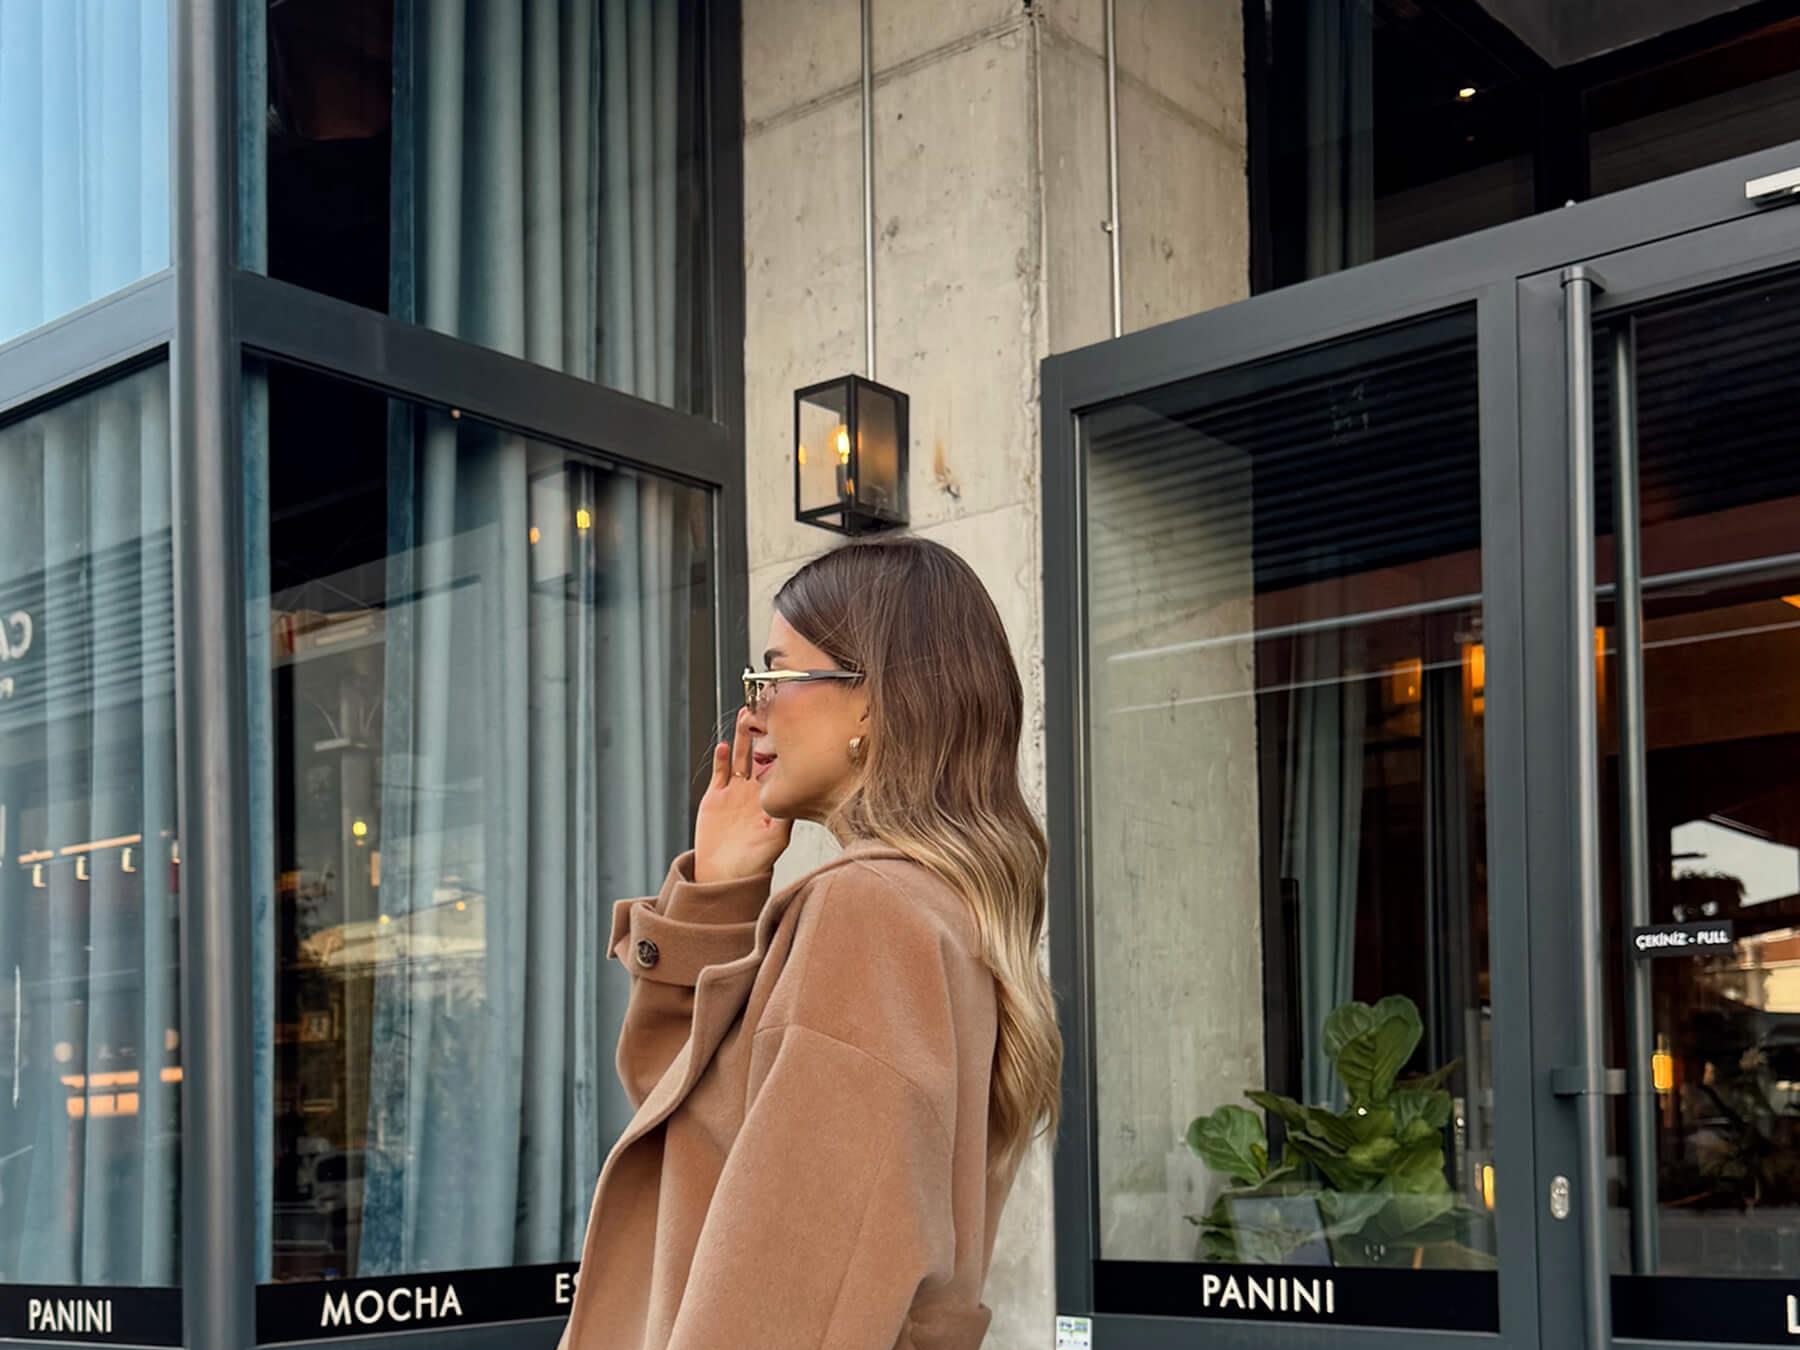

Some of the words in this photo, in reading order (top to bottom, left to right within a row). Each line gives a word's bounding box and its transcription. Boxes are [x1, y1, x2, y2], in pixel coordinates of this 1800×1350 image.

[1697, 930, 1730, 945] PULL
[320, 1283, 463, 1328] MOCHA
[1202, 1273, 1335, 1314] PANINI
[28, 1298, 112, 1334] PANINI
